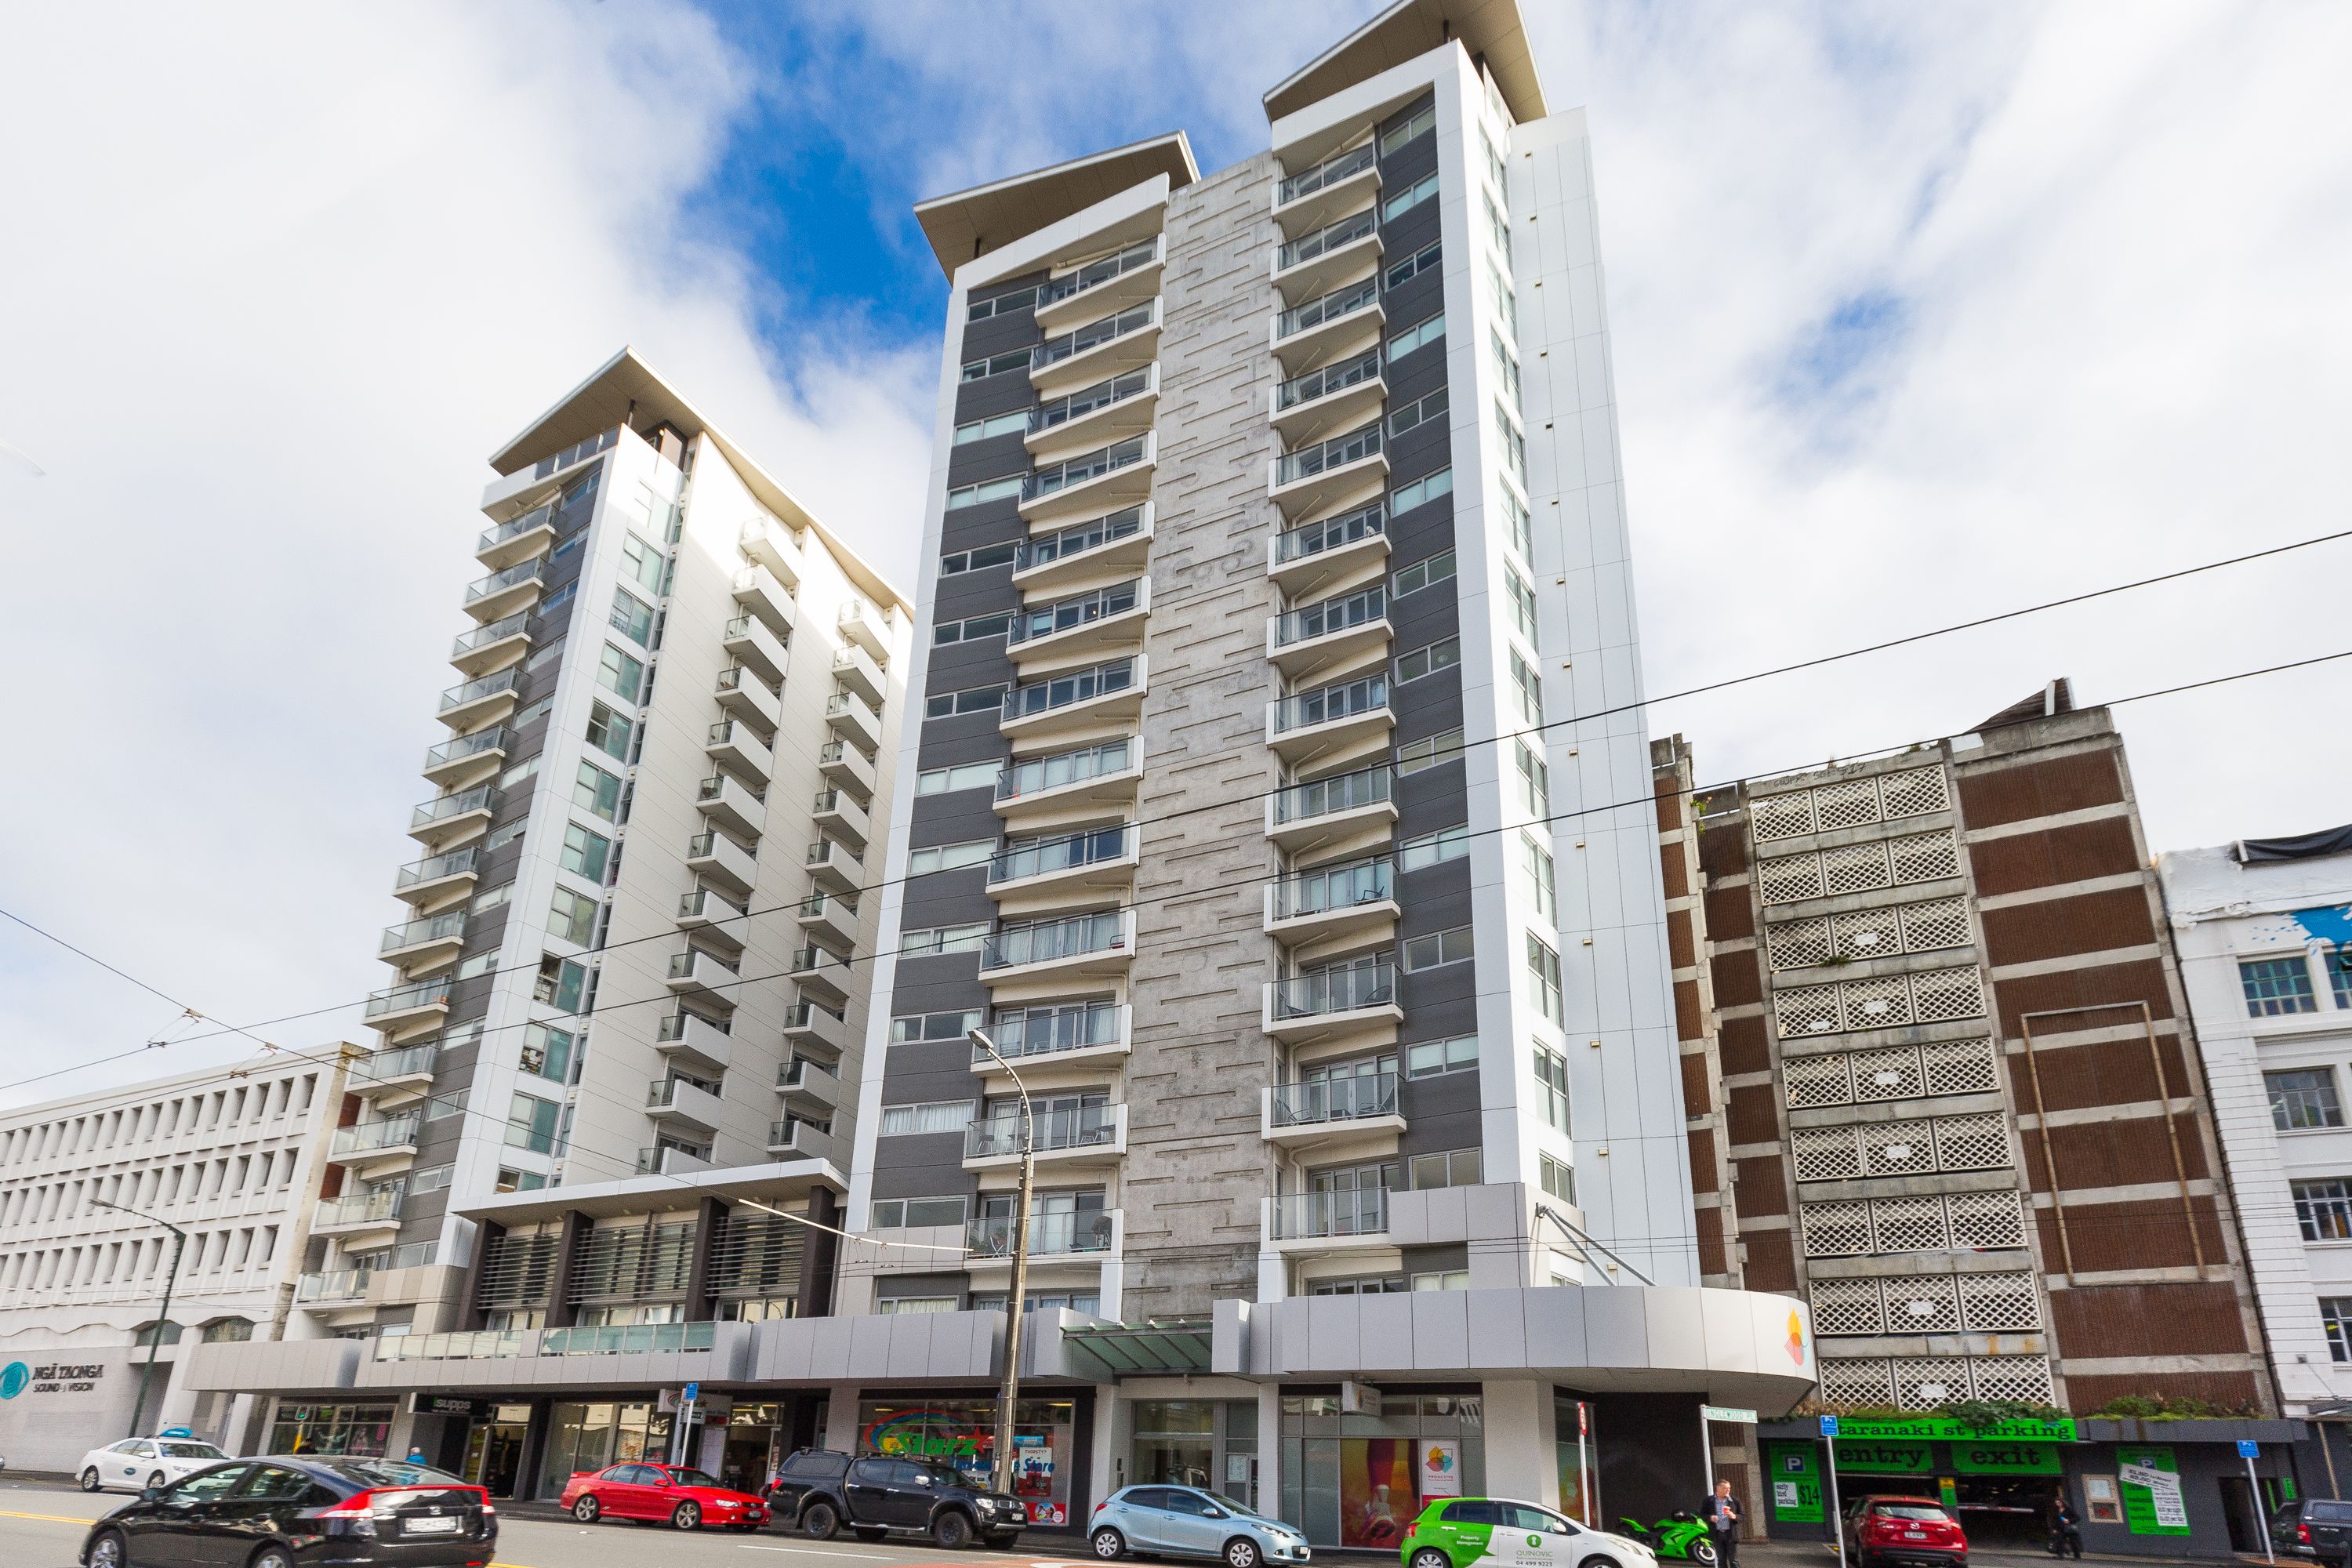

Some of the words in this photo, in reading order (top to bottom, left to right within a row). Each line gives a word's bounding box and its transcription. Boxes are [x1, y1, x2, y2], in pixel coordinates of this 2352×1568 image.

[1838, 1424, 1936, 1436] taranaki
[1944, 1425, 1965, 1436] st
[1974, 1424, 2071, 1439] parking
[892, 1432, 979, 1456] Starz
[1838, 1446, 1923, 1468] entry
[1971, 1445, 2042, 1465] exit
